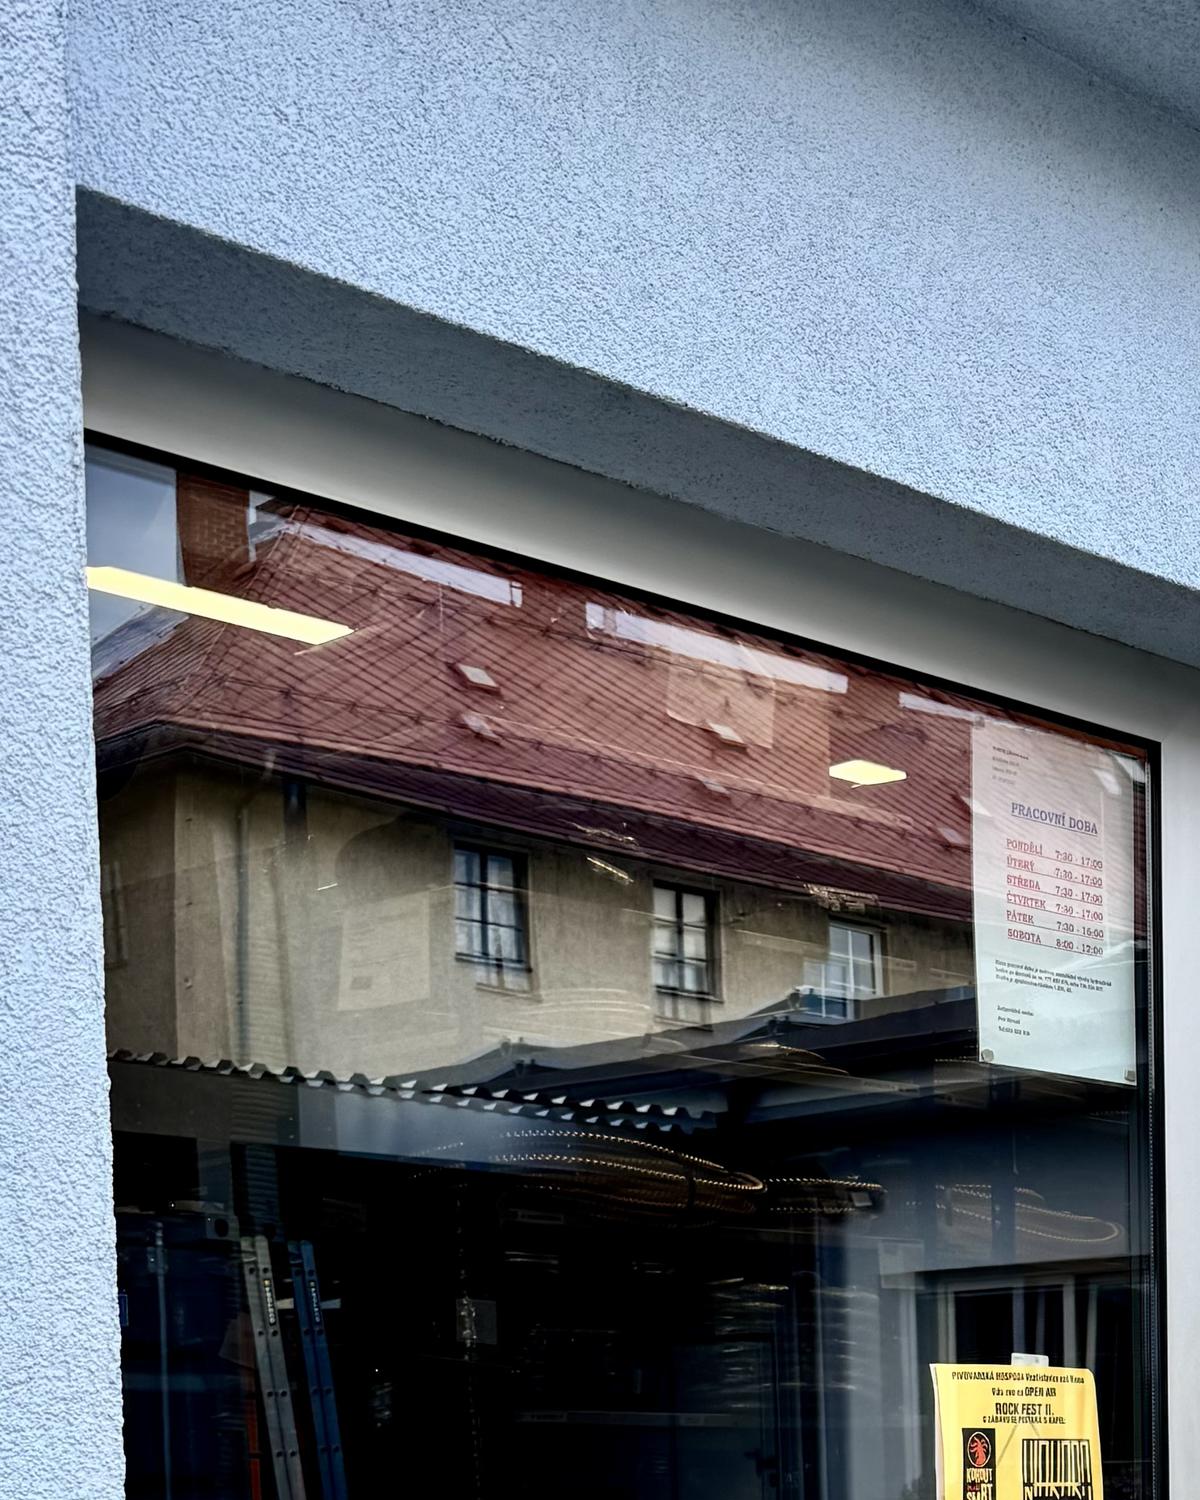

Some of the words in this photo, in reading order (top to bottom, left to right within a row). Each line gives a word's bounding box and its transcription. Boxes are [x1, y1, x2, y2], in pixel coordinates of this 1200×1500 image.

[1011, 802, 1066, 827] PRACOVNÍ
[1069, 816, 1098, 834] DOBA
[1006, 838, 1043, 856] PONDĚLÍ
[1081, 856, 1103, 869] 17:00
[1007, 854, 1035, 872] ÚTERÝ
[1081, 874, 1103, 887] 17:00
[1006, 874, 1041, 890] STŘEDA
[1081, 892, 1103, 904] 17:00
[1006, 890, 1046, 910] ČTVRTEK
[1082, 909, 1103, 921] 17:00
[1006, 909, 1035, 924] PÁTEK
[1082, 926, 1104, 938] 16:00
[1007, 928, 1042, 944] SOBOTA
[1082, 943, 1103, 955] 12:00
[1024, 1386, 1044, 1397] OPEN
[1045, 1387, 1056, 1397] AIR
[995, 1402, 1019, 1415] ROCK
[1021, 1403, 1042, 1415] FEST
[1045, 1403, 1055, 1415] II.
[966, 1468, 993, 1483] KOHOUT
